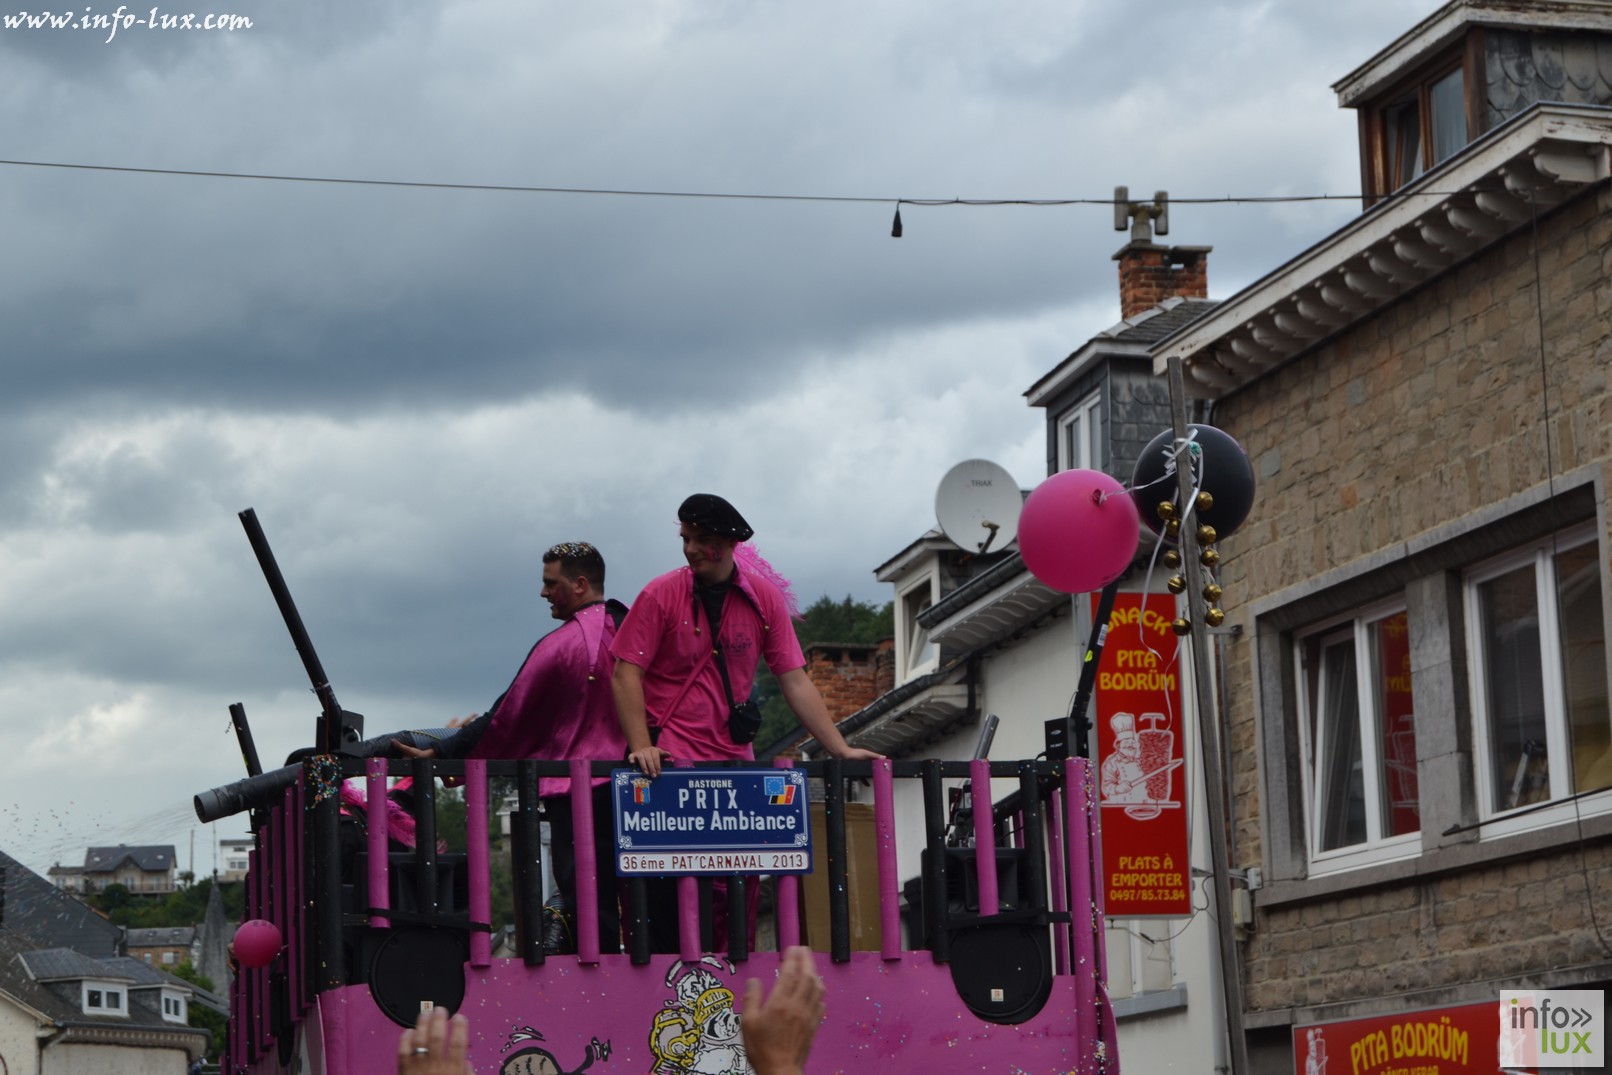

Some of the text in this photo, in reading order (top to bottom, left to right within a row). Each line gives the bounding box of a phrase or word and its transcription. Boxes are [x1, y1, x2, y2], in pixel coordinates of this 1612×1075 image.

[1116, 650, 1157, 668] PITA
[1099, 669, 1176, 691] BODRÜM
[688, 779, 733, 789] BASTOGNE
[678, 788, 738, 809] PRIX
[623, 810, 796, 832] Meilleure Ambiance
[672, 854, 764, 869] PAT'CARNAVAL
[772, 854, 803, 868] 2013
[1119, 852, 1174, 870] PLATS À
[1111, 872, 1183, 887] EMPORTER
[1110, 888, 1186, 901] 0497/85.73.84
[1350, 1016, 1468, 1075] PITA BODRÜM
